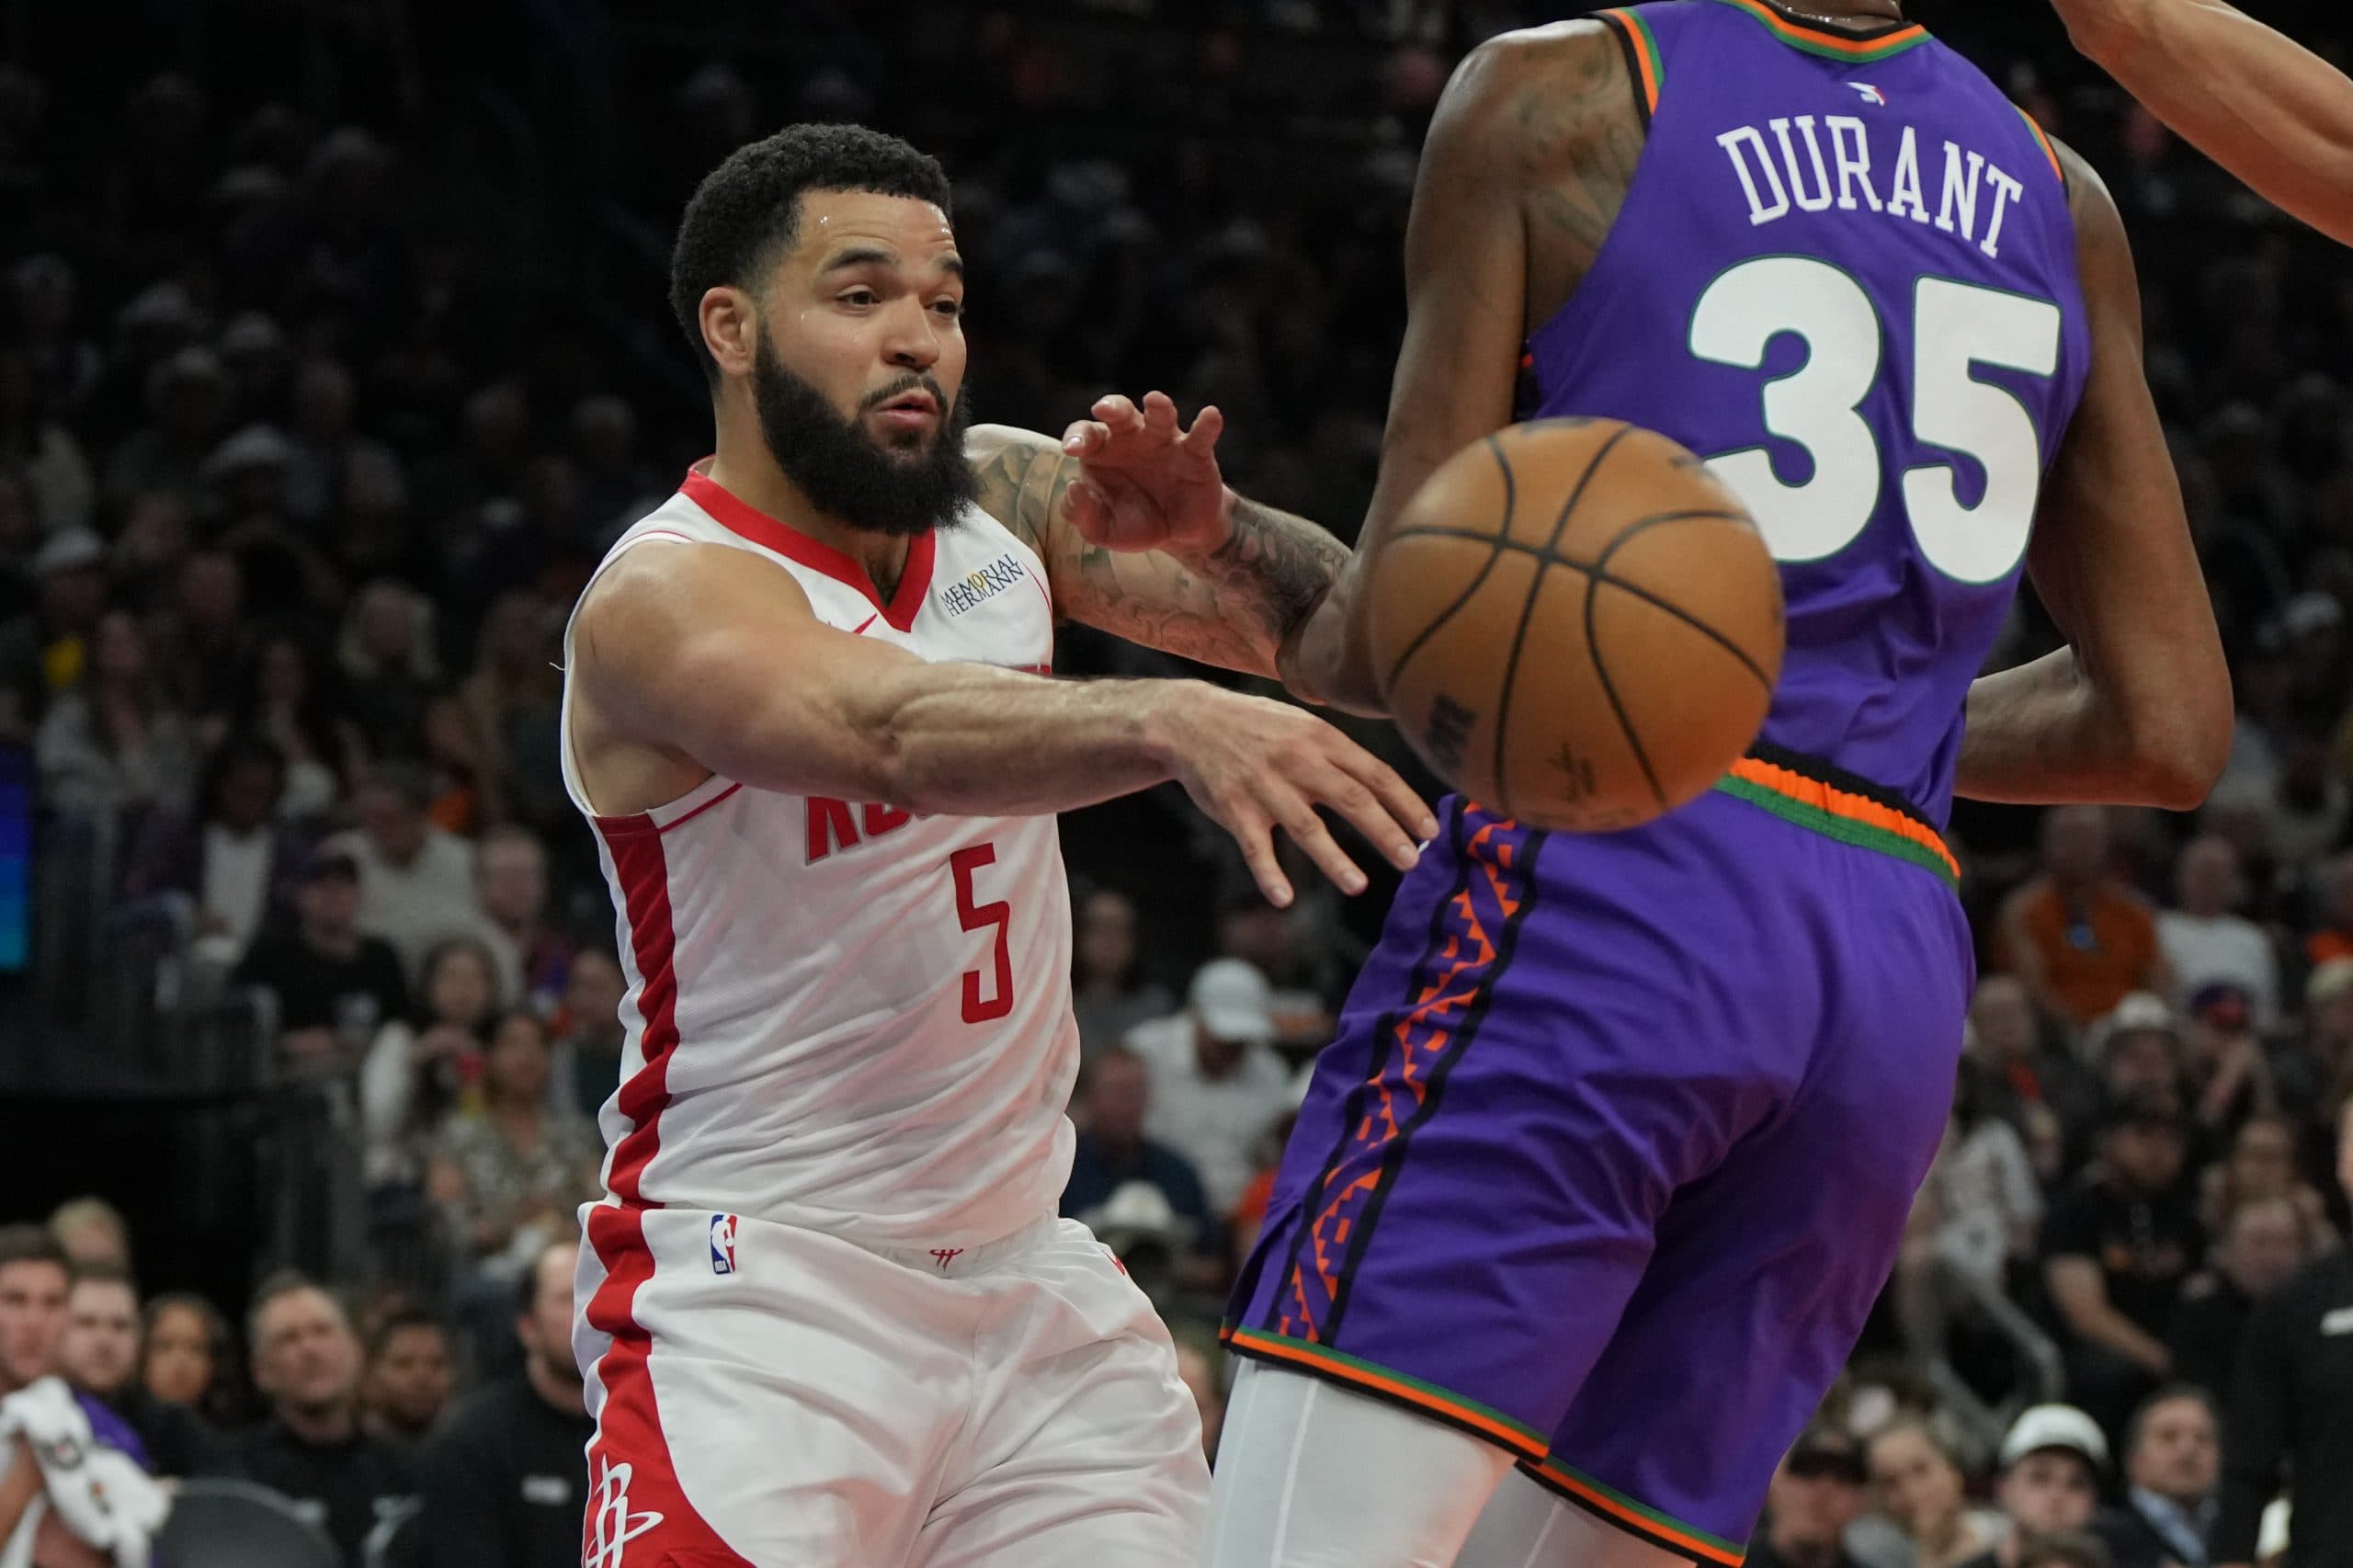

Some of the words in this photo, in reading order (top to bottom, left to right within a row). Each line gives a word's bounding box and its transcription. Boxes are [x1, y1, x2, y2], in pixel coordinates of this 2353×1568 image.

[1716, 115, 2023, 258] DURANT
[1688, 253, 2062, 586] 35
[940, 553, 1018, 605] MEMORIAL
[943, 562, 1025, 617] HERMANN
[949, 842, 1015, 1025] 5
[714, 1260, 728, 1272] NBA
